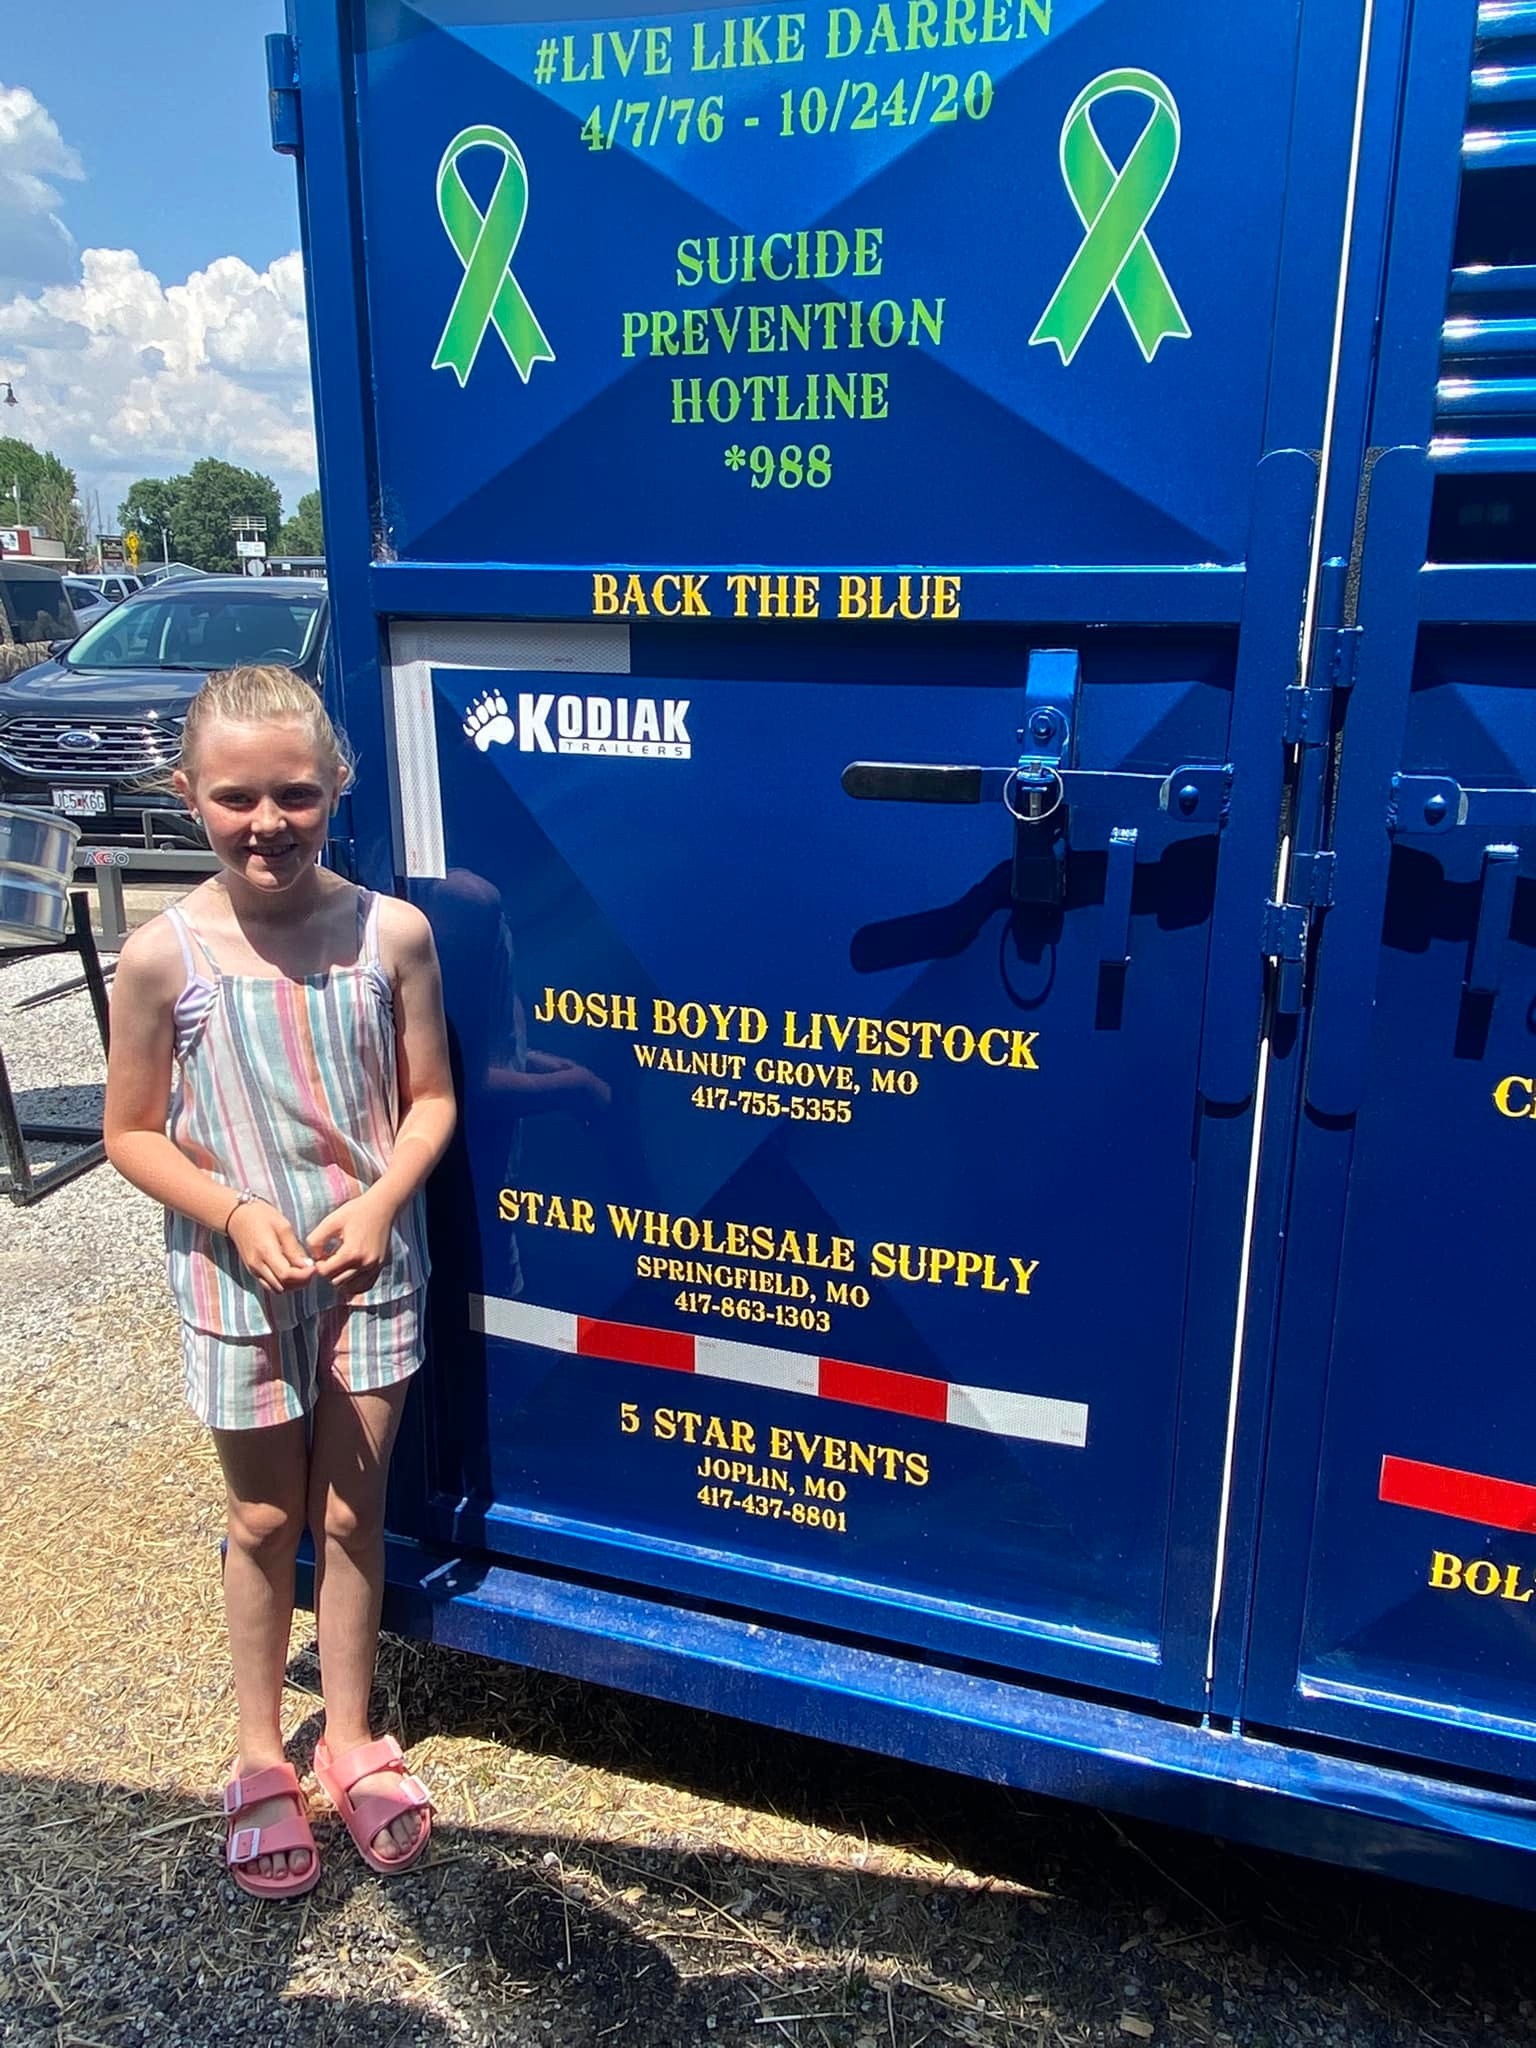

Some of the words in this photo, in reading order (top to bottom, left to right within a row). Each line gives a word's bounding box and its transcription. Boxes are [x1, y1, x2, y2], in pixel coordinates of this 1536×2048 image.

[534, 27, 671, 85] #LIVE
[691, 14, 805, 71] LIKE
[826, 0, 1052, 58] DARREN
[581, 96, 724, 150] 4/7/76
[780, 70, 994, 136] 10/24/20
[677, 229, 882, 286] SUICIDE
[622, 298, 944, 357] PREVENTION
[672, 373, 888, 423] HOTLINE
[593, 574, 711, 616] BACK
[727, 575, 819, 617] THE
[838, 576, 960, 619] BLUE
[519, 693, 691, 752] KODIAK
[567, 742, 683, 757] TRAILERS
[535, 988, 638, 1030] JOSH
[653, 999, 768, 1043] BOYD
[783, 1011, 1039, 1069] LIVESTOCK
[634, 1045, 746, 1079] WALNUT
[755, 1059, 860, 1094] GROVE,
[872, 1069, 918, 1094] MO
[692, 1086, 851, 1123] 417-755-5355
[497, 1188, 596, 1234] STAR
[607, 1203, 855, 1273] WHOLESALE
[871, 1243, 1039, 1294] SUPPLY
[636, 1255, 816, 1303] SPRINGFIELD,
[827, 1281, 869, 1307] MO
[675, 1291, 830, 1332] 417-863-1303
[622, 1403, 639, 1432] 5
[655, 1408, 755, 1453] STAR
[769, 1427, 929, 1486] EVENTS
[698, 1457, 795, 1496] JOPLIN,
[805, 1476, 846, 1501] MO
[697, 1485, 848, 1532] 417-437-8801
[1428, 1551, 1536, 1602] BOL
